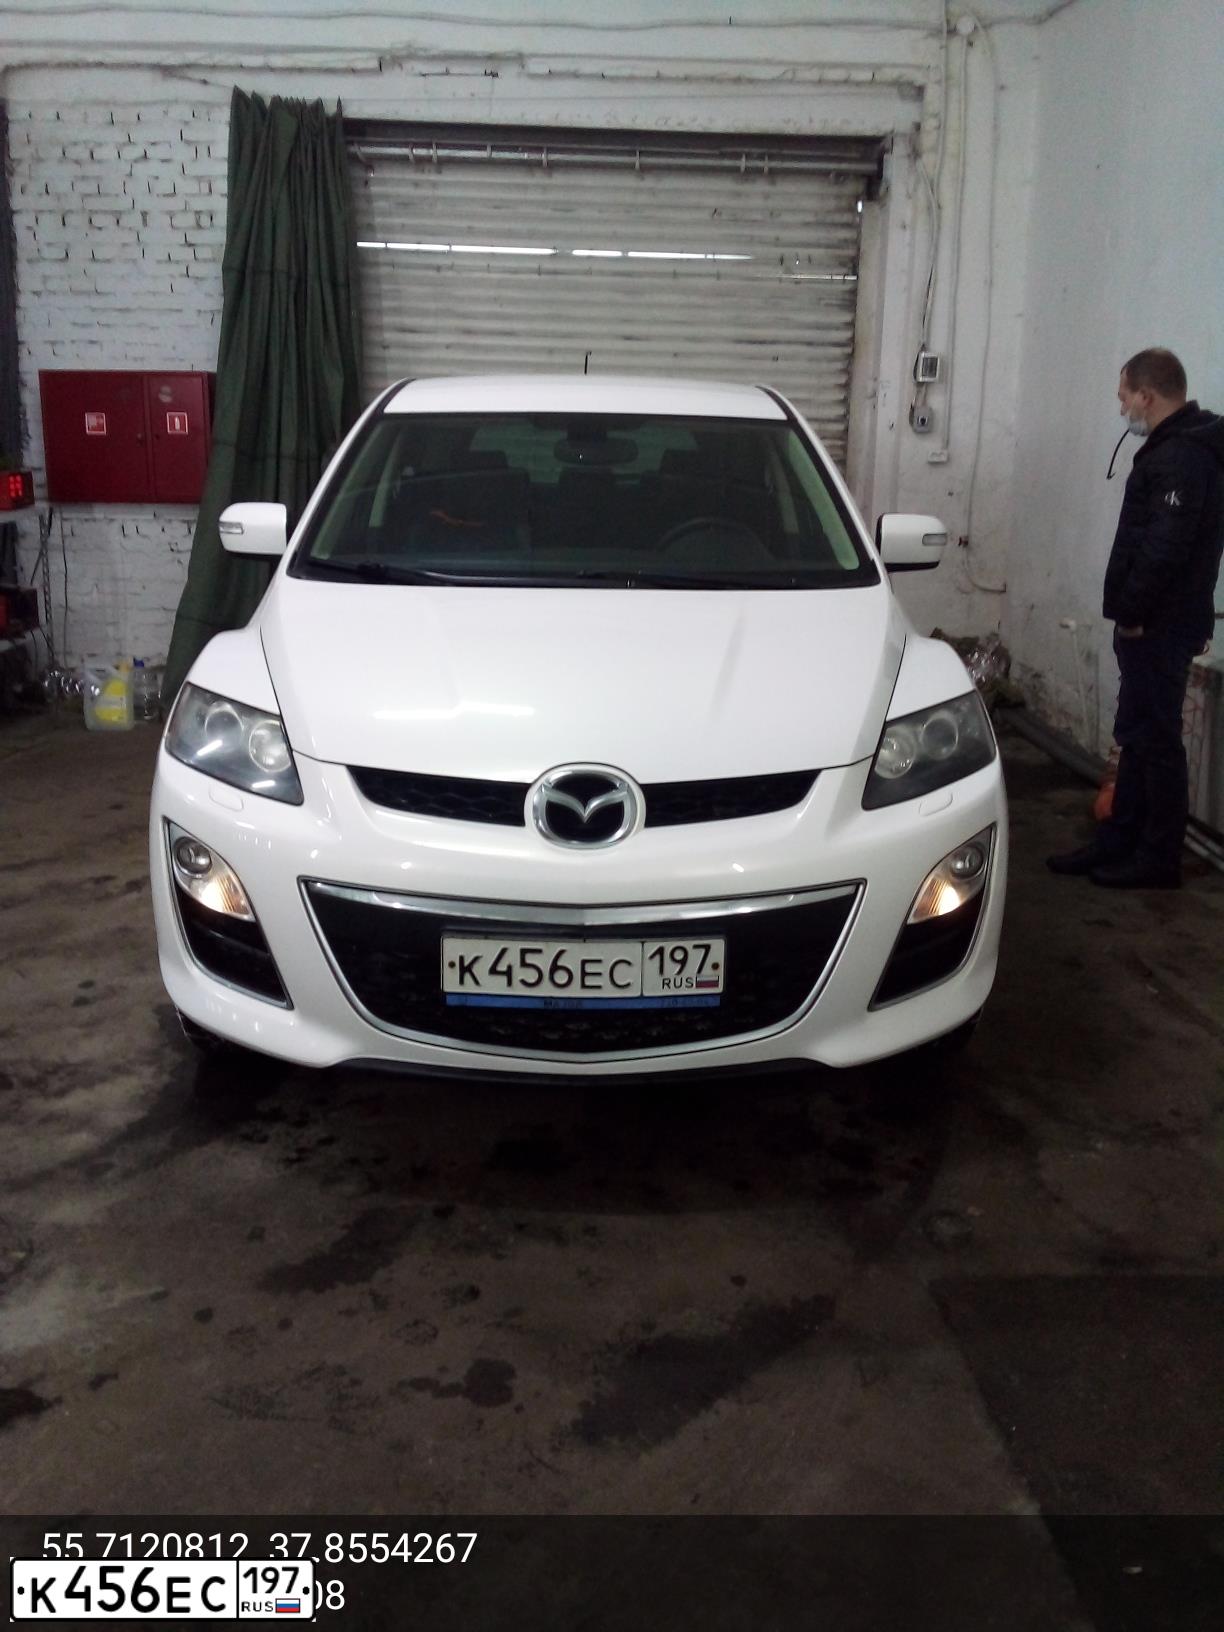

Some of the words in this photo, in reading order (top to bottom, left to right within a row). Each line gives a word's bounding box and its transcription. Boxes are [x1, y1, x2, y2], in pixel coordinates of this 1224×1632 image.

[458, 947, 633, 990] K456EC
[648, 944, 711, 976] 197
[662, 977, 694, 989] RUS
